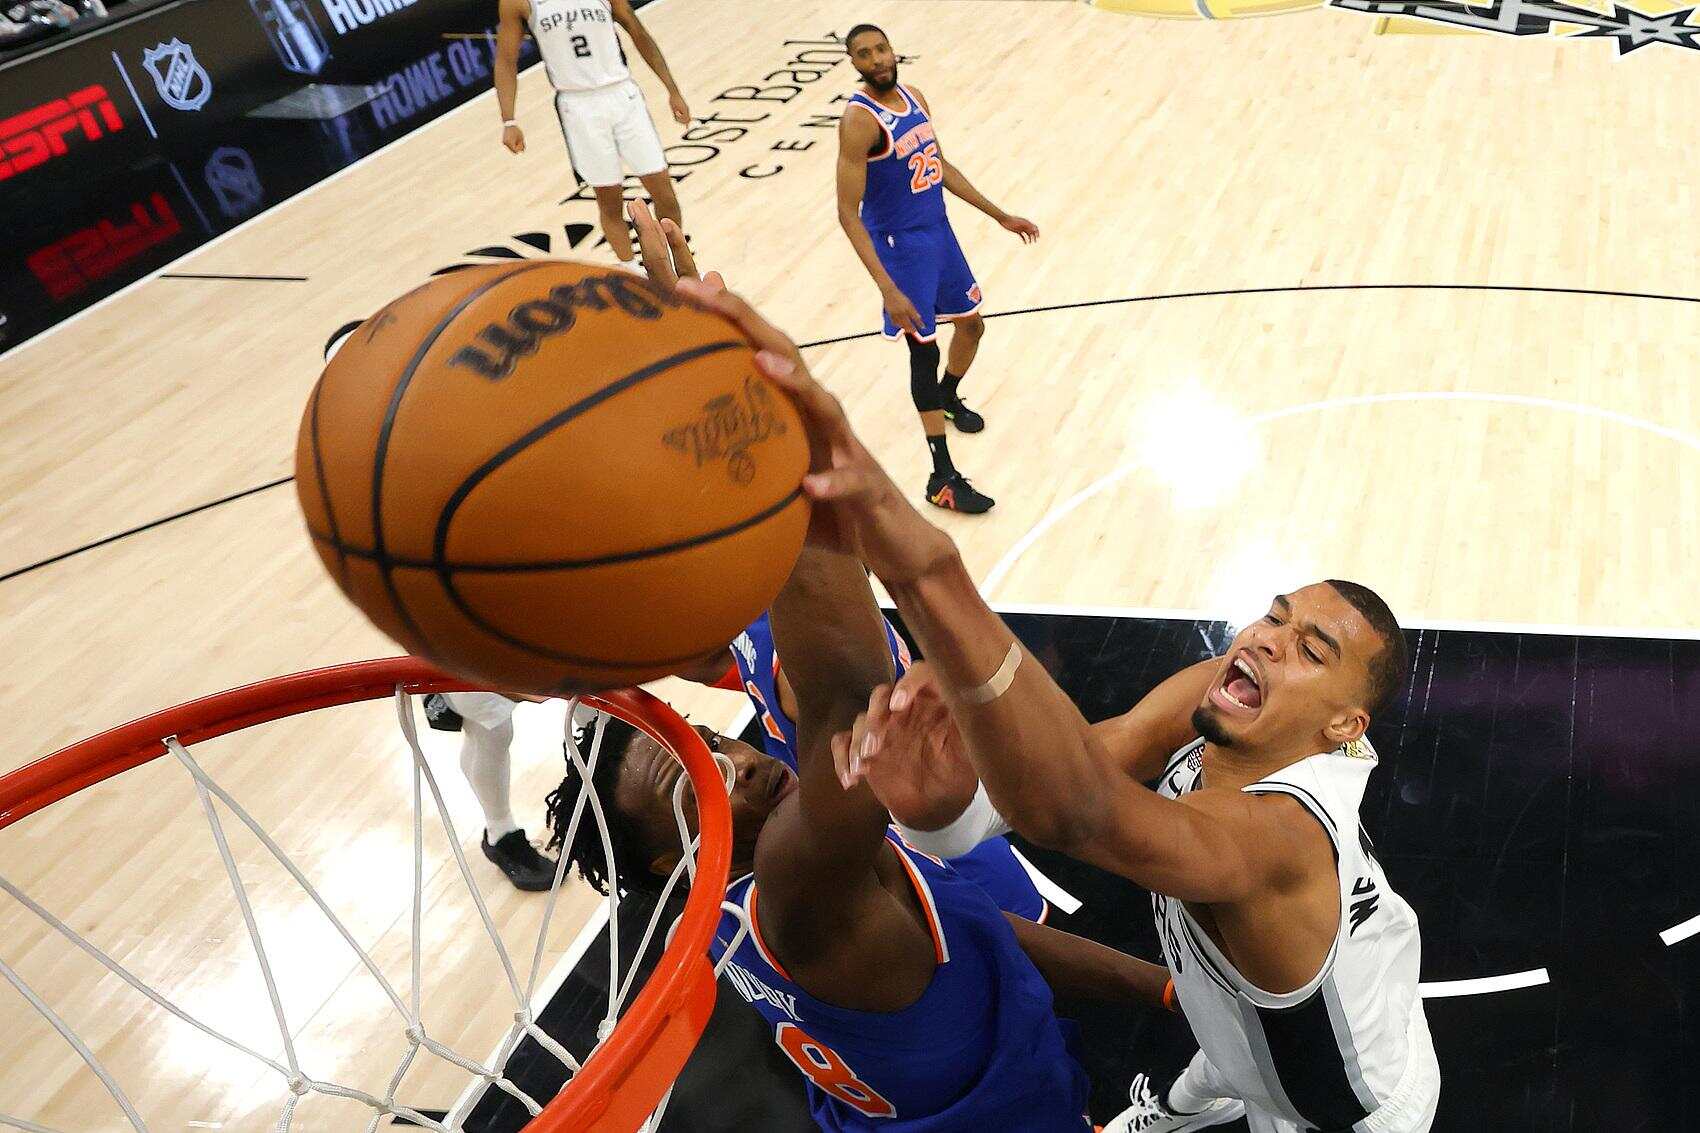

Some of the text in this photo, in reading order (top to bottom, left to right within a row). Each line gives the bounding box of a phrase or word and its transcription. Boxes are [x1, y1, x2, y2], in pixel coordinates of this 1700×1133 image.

[540, 8, 607, 32] SPURS
[570, 34, 591, 57] 2
[908, 142, 943, 194] 25
[775, 1021, 897, 1118] 8
